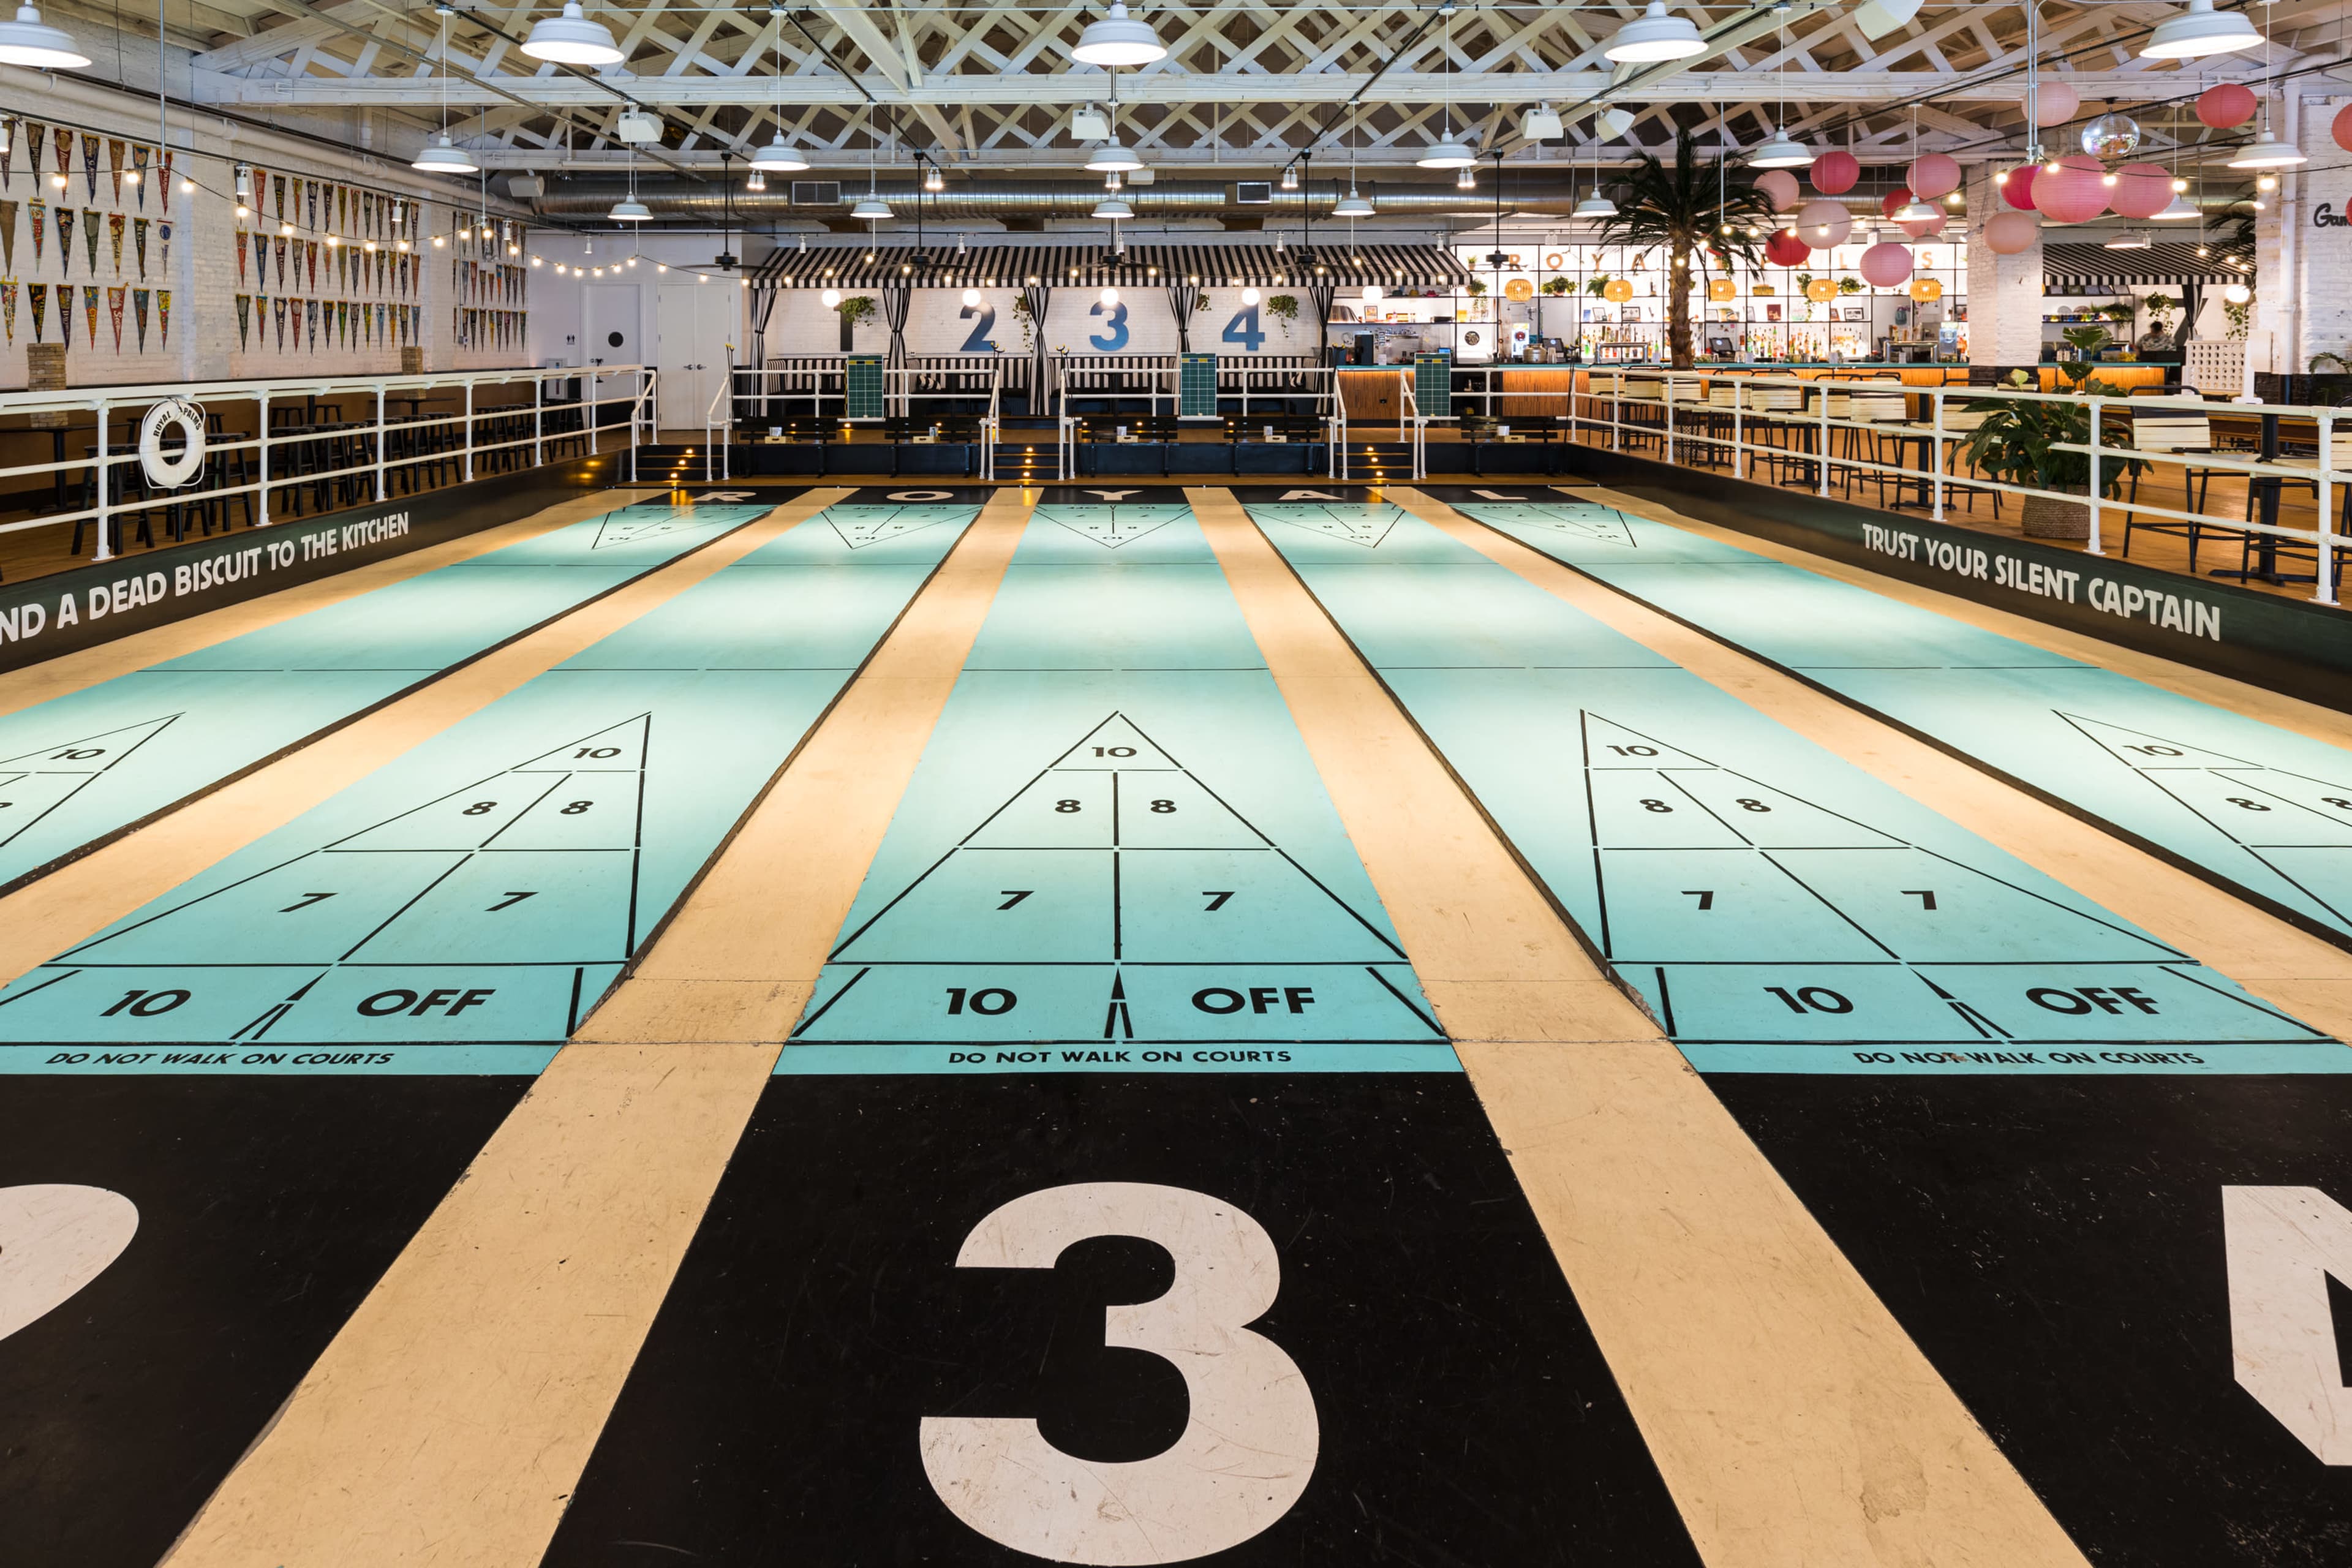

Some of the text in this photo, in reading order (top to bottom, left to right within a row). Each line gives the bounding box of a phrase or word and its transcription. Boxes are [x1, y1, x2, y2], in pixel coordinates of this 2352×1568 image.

[960, 301, 996, 352] 2
[1090, 299, 1129, 351] 3
[1222, 301, 1265, 351] 4
[153, 407, 202, 437] ROYAL PALMS
[56, 593, 78, 629] A
[89, 571, 167, 620] DEAD
[175, 546, 262, 597] BISCUIT
[267, 540, 295, 571] TO
[301, 529, 337, 561] THE
[342, 511, 409, 551] KITCHEN
[1862, 523, 2220, 641] TRUST YOUR SILENT CAPTAIN
[49, 748, 106, 760] 10
[573, 747, 622, 759] 10
[1091, 747, 1137, 758] 10
[1606, 745, 1659, 756] 10
[2122, 745, 2184, 756] 10
[462, 801, 594, 816] 8 8
[1055, 799, 1177, 814] 8 8
[1640, 798, 1771, 813] 8 8
[2225, 797, 2271, 812] 8
[277, 892, 538, 913] 7 7
[997, 891, 1235, 911] 7 7
[1681, 890, 1937, 910] 7 7
[99, 989, 496, 1017] 10 OFF
[947, 987, 1316, 1016] 10 OFF
[1763, 986, 2160, 1015] 10 OFF
[45, 1053, 395, 1065] DO NOT WALK ON COURTS
[949, 1050, 1292, 1064] DO NOT WALK ON COURTS
[1852, 1052, 2205, 1064] DO NOT WALK ON COURTS
[919, 1182, 1320, 1567] 3
